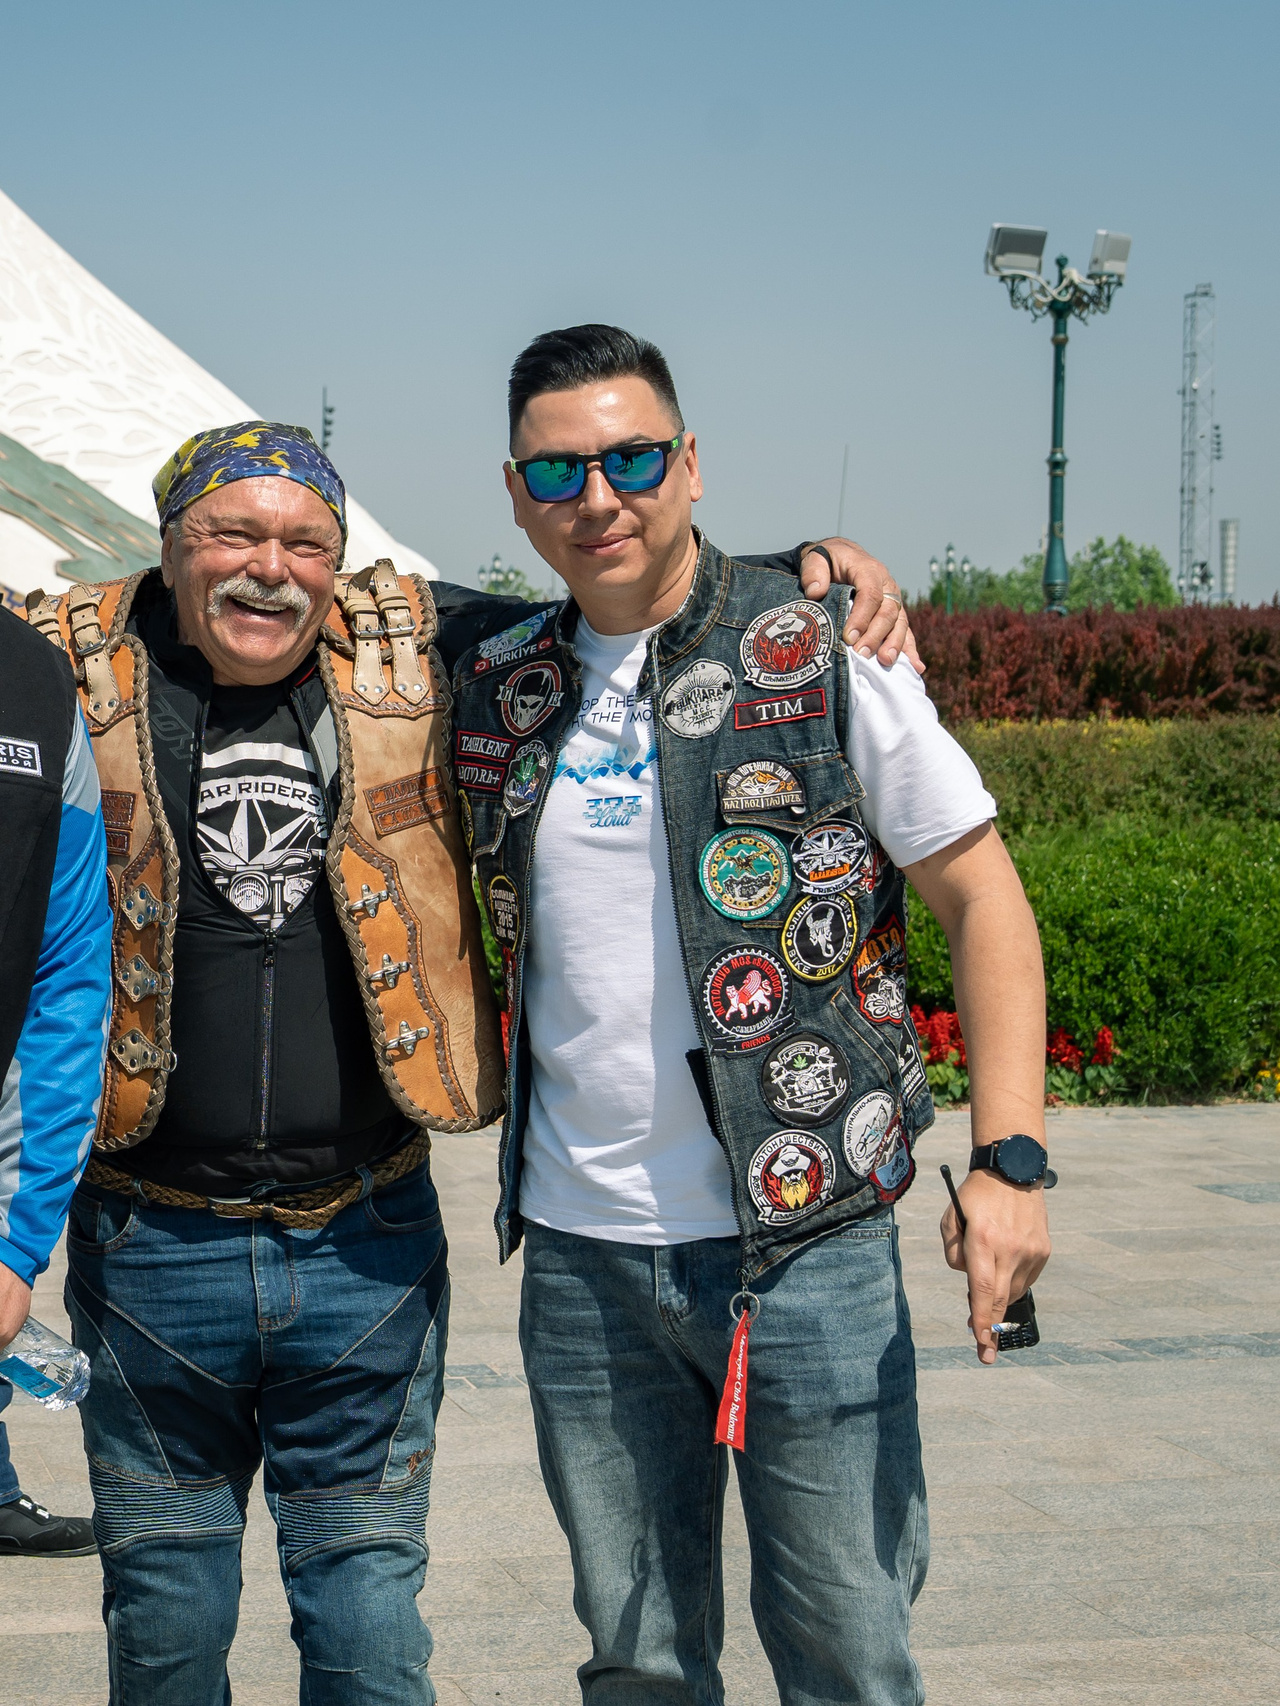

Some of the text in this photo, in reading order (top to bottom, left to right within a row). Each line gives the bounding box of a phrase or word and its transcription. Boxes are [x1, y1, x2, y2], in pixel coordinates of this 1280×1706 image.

[751, 604, 823, 634] МОТОНАШЕСТВИЕ
[581, 697, 599, 711] OP
[606, 694, 635, 708] THE
[676, 688, 724, 711] BUKHARA
[755, 697, 805, 721] TIM
[571, 710, 653, 728] HT THE MO
[461, 735, 510, 758] TASHKENT
[199, 781, 322, 808] AR RIDERS
[590, 806, 633, 828] Loud
[786, 899, 813, 938] СОЛНЦЕ
[789, 934, 854, 974] BIKE FEST
[816, 964, 837, 977] 2017
[711, 965, 731, 1017] МОТОКЛУБ
[741, 1033, 771, 1050] FRIENDS
[754, 1135, 825, 1170] МОТОНАШЕСТВИЕ
[735, 1334, 747, 1379] Motorcycle
[732, 1380, 742, 1402] Club
[726, 1402, 740, 1442] Baikonur
